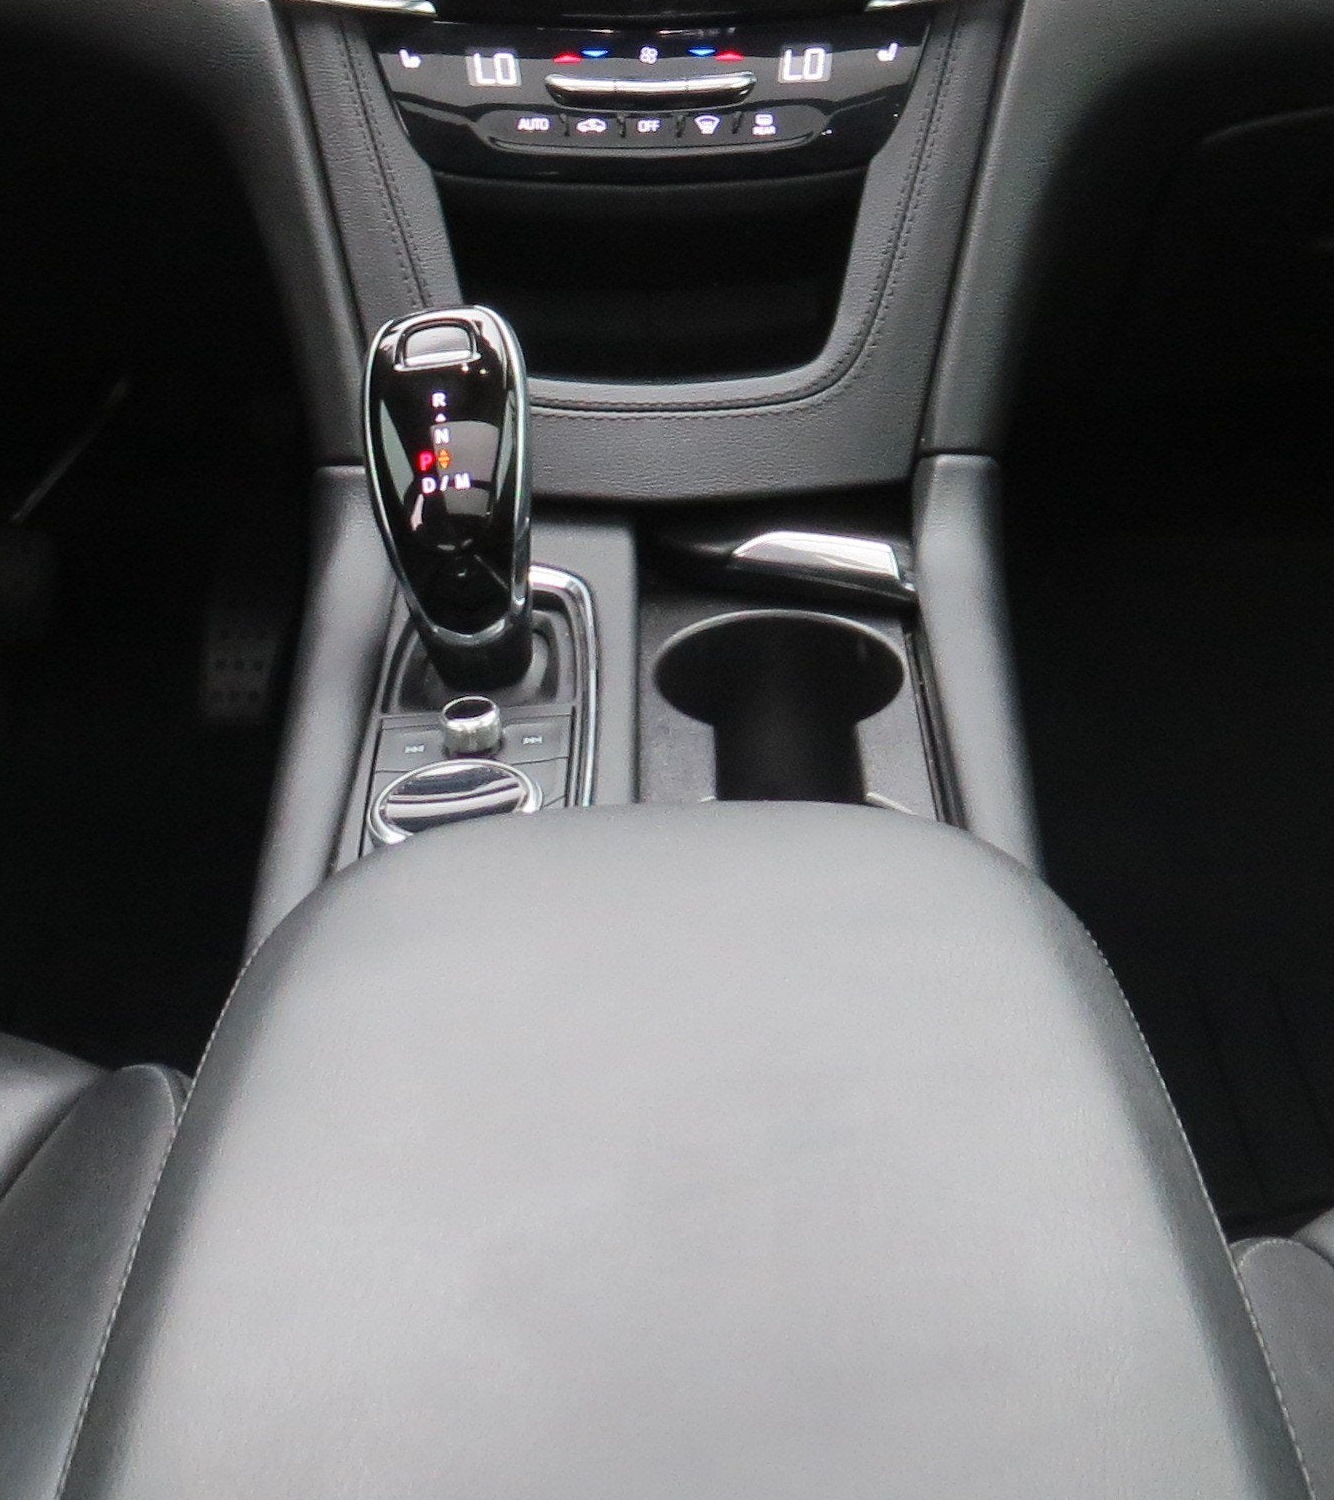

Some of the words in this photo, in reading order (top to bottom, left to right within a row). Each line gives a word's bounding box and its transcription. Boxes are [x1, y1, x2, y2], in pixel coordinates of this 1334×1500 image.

[473, 52, 517, 85] LO
[783, 48, 827, 81] LO
[517, 117, 550, 131] AUTO
[637, 119, 661, 133] OFF
[431, 392, 447, 407] R
[434, 428, 449, 444] N
[419, 450, 434, 471] P
[421, 476, 437, 494] D
[455, 473, 471, 490] M
